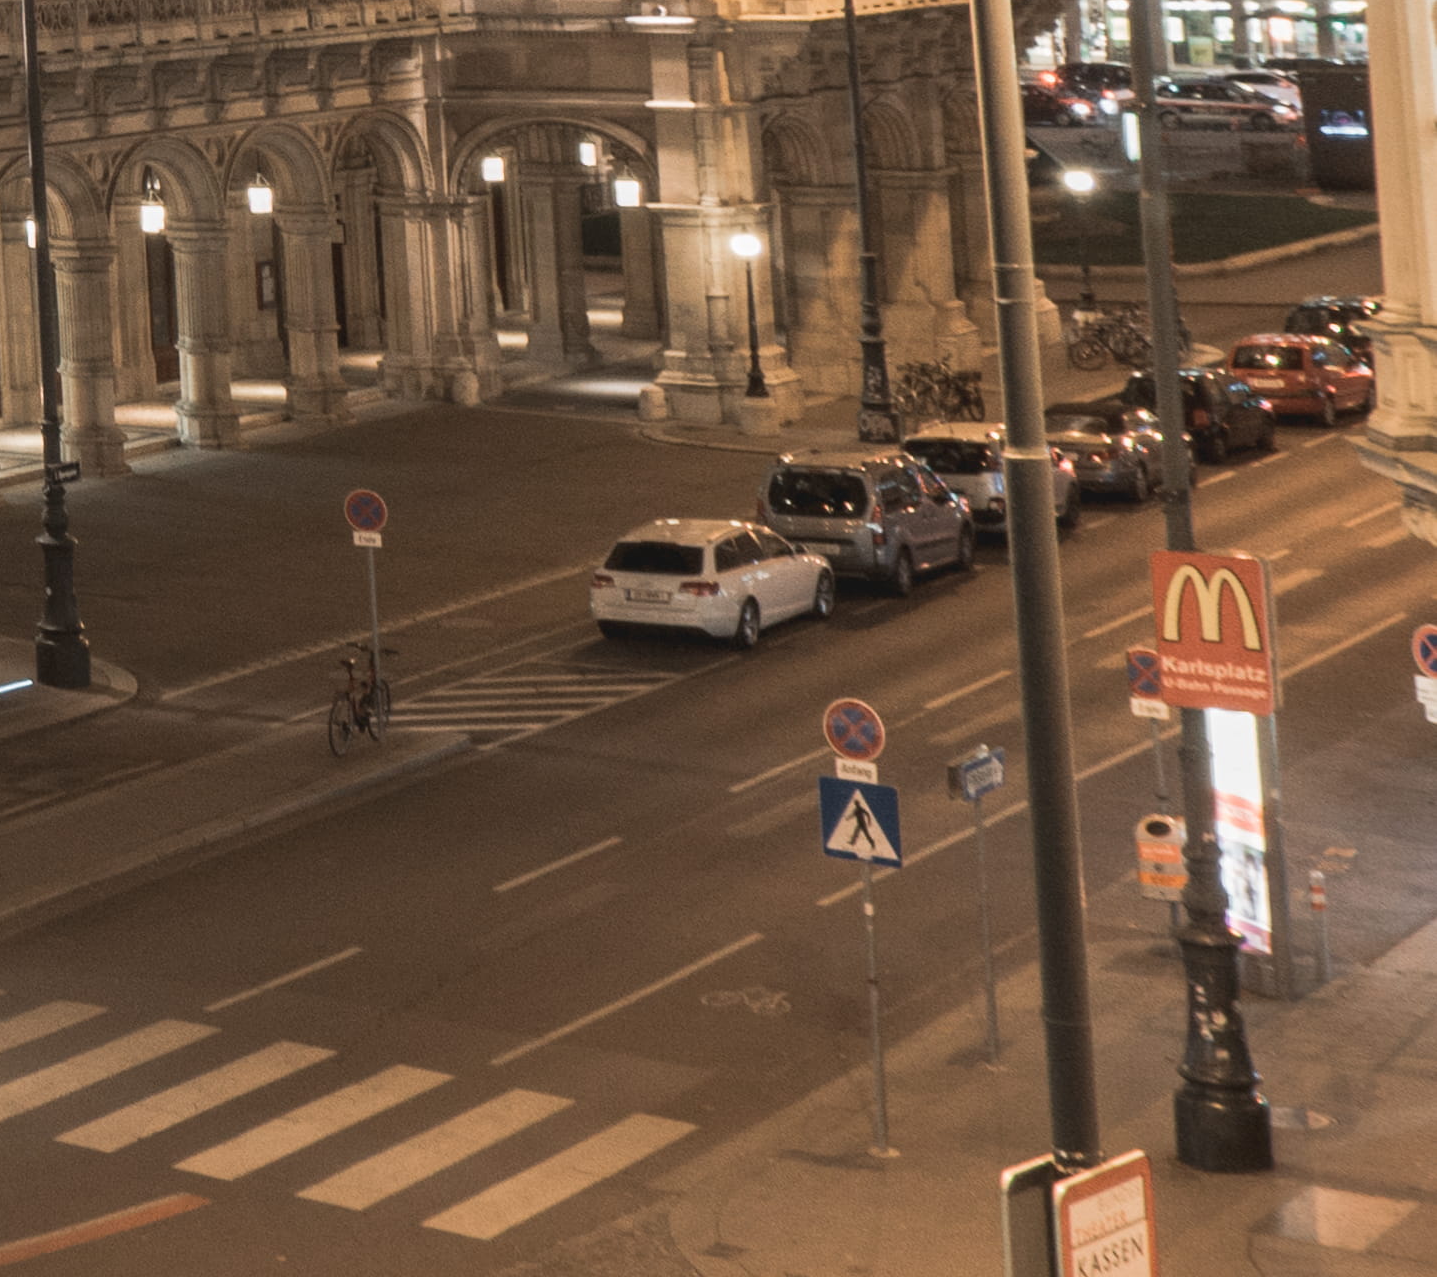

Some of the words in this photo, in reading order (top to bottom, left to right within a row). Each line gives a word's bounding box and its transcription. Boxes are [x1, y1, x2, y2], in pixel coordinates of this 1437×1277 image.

[1162, 656, 1267, 683] Karlsplatz
[841, 762, 873, 780] Anfang
[1078, 1233, 1144, 1277] KASSEN
